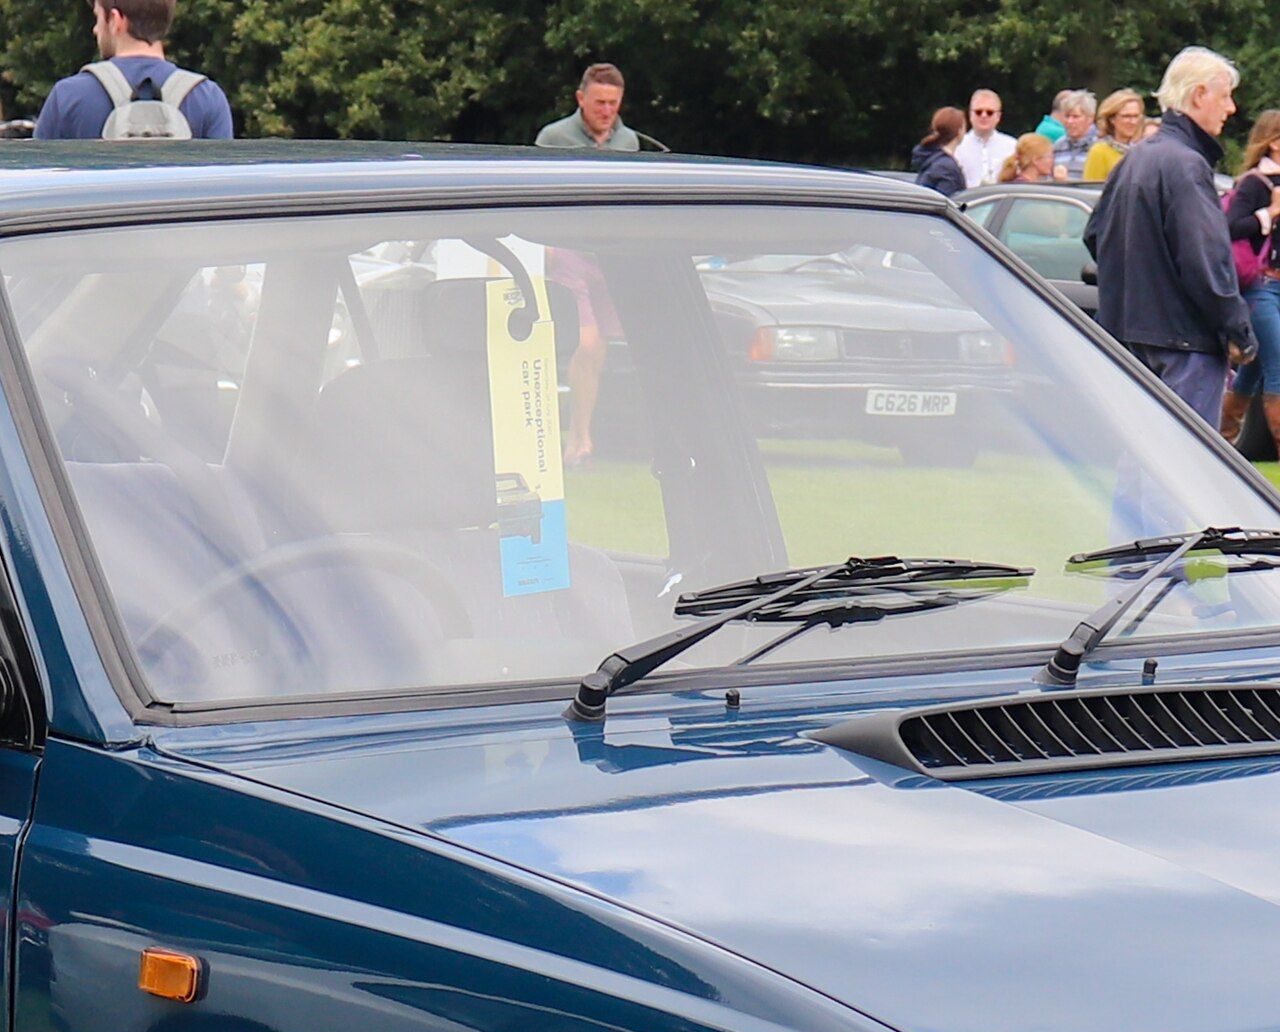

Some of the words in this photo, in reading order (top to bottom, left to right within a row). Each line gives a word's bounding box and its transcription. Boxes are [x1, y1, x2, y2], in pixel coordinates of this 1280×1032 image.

[522, 360, 530, 386] car
[522, 391, 533, 426] park
[533, 360, 547, 472] Unexceptional
[873, 393, 918, 412] C626
[921, 395, 950, 413] MRP
